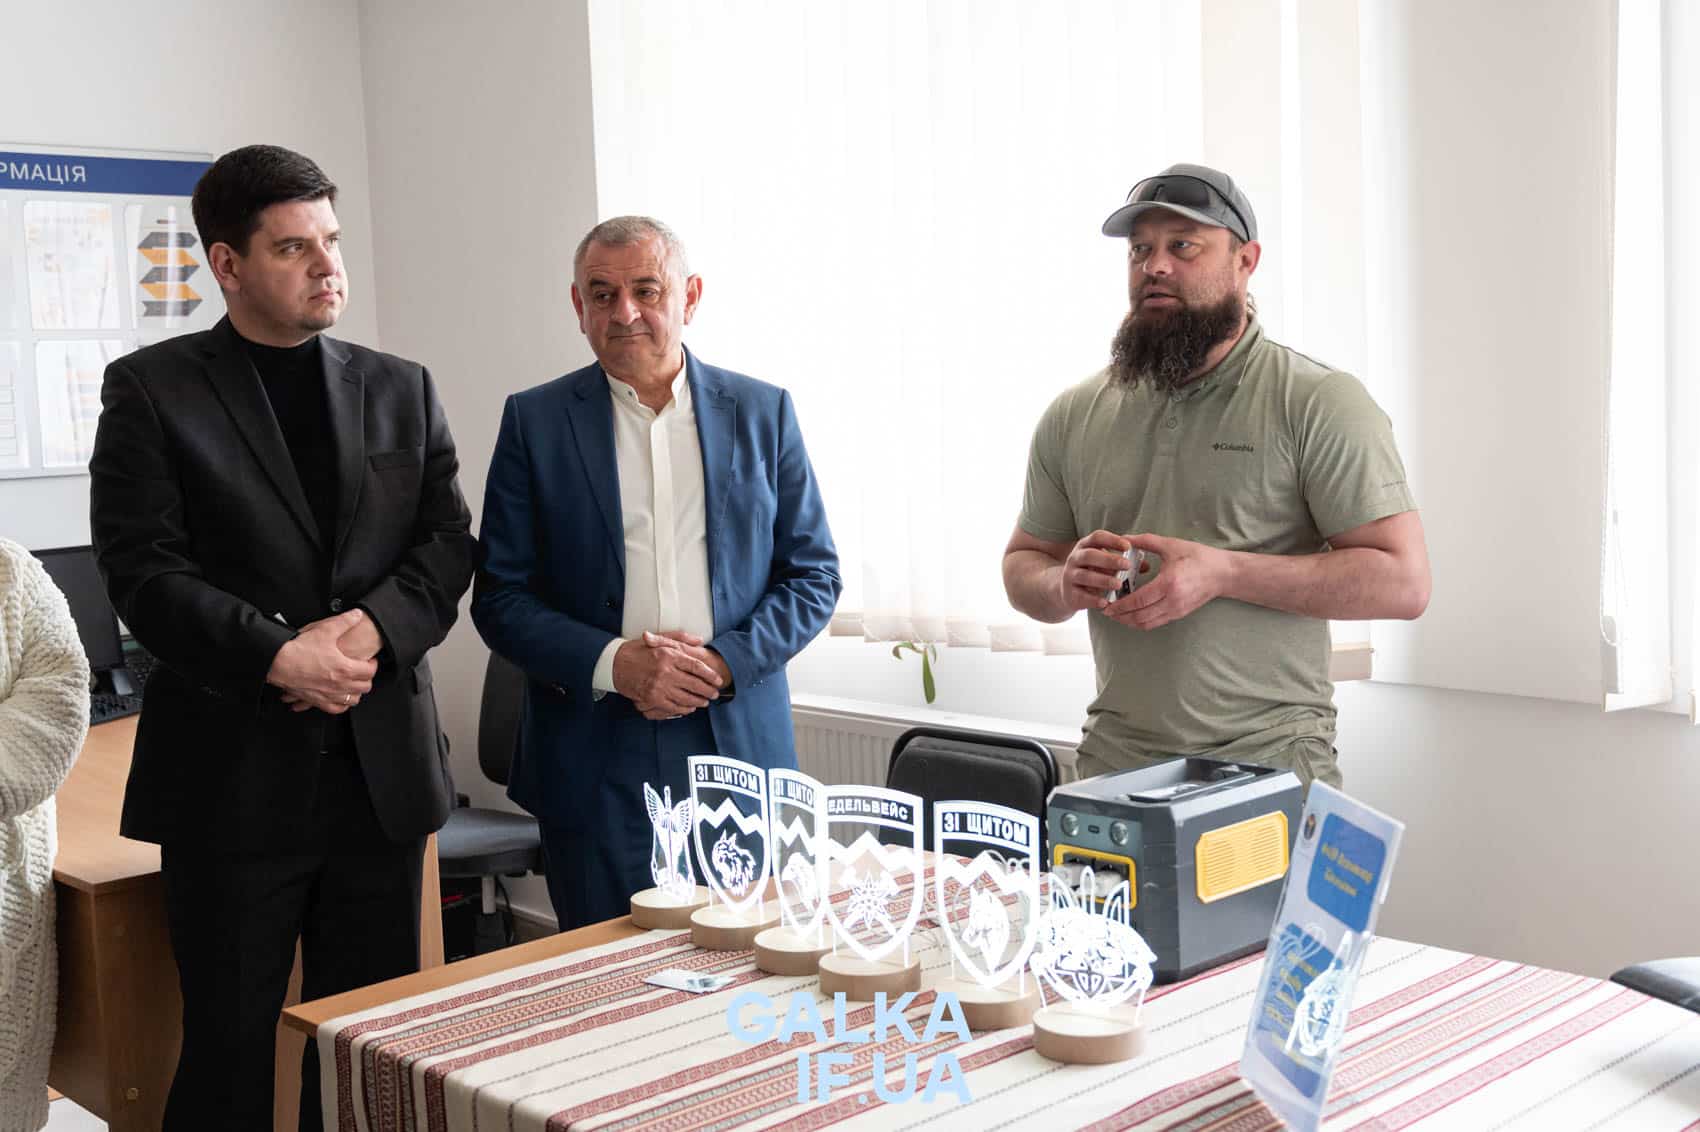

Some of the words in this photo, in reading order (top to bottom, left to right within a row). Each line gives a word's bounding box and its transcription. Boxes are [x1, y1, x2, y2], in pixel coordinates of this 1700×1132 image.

[696, 765, 708, 781] ЗІ
[713, 765, 758, 793] ЩИТОМ
[788, 780, 813, 805] ЩИТО
[828, 799, 908, 820] ЕДЕЛЬВЕЙС
[944, 815, 960, 832] ЗІ
[967, 815, 1028, 845] ЩИТОМ
